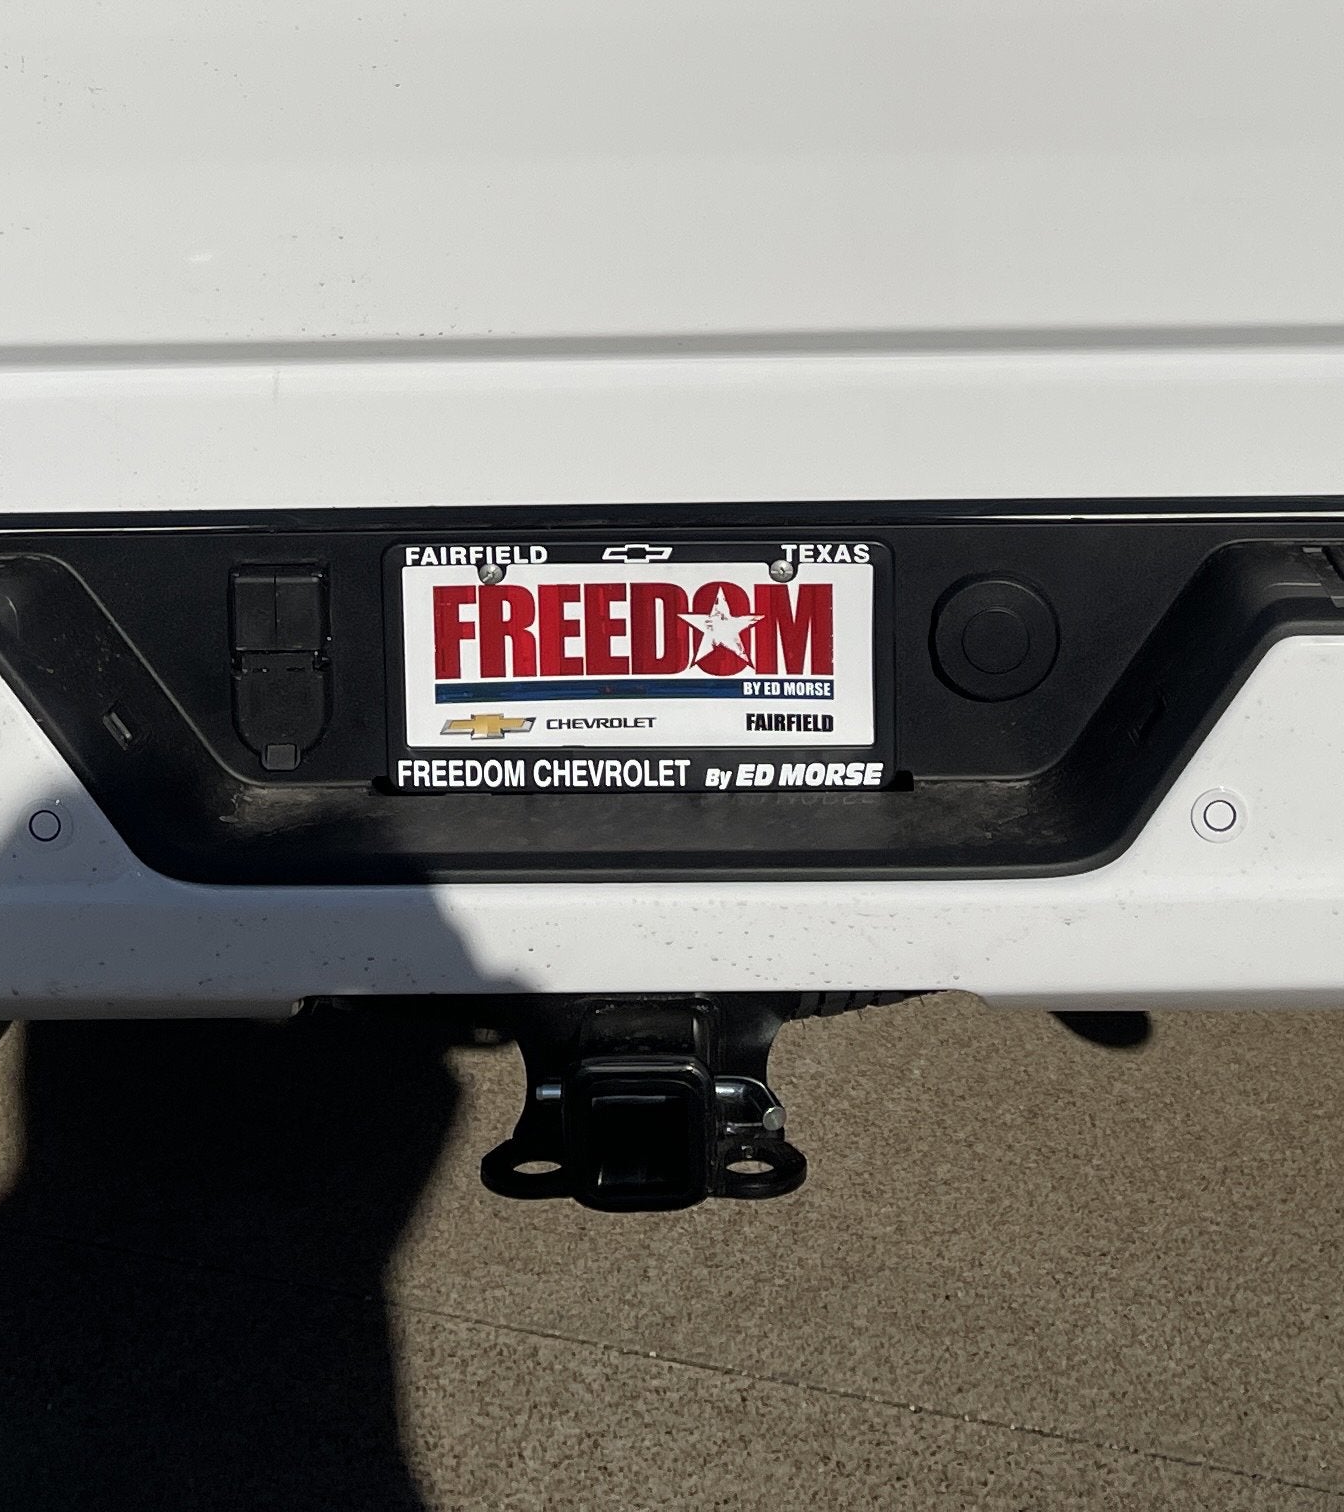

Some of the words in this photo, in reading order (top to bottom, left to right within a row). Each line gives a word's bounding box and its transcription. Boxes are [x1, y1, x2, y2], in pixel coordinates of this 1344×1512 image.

[405, 545, 548, 566] FAIRFIELD
[781, 544, 870, 564] TEXAS
[432, 581, 834, 680] FREEDOM
[743, 681, 761, 696] BY
[763, 681, 781, 696] ED
[783, 681, 831, 697] MORSE
[546, 717, 657, 730] CHEVROLET
[746, 713, 834, 732] FAIRFIELD
[397, 759, 524, 788] FREEDOM
[533, 758, 691, 788] CHEVROLET
[704, 767, 733, 790] By
[735, 763, 775, 787] ED
[777, 762, 884, 787] MORSE
